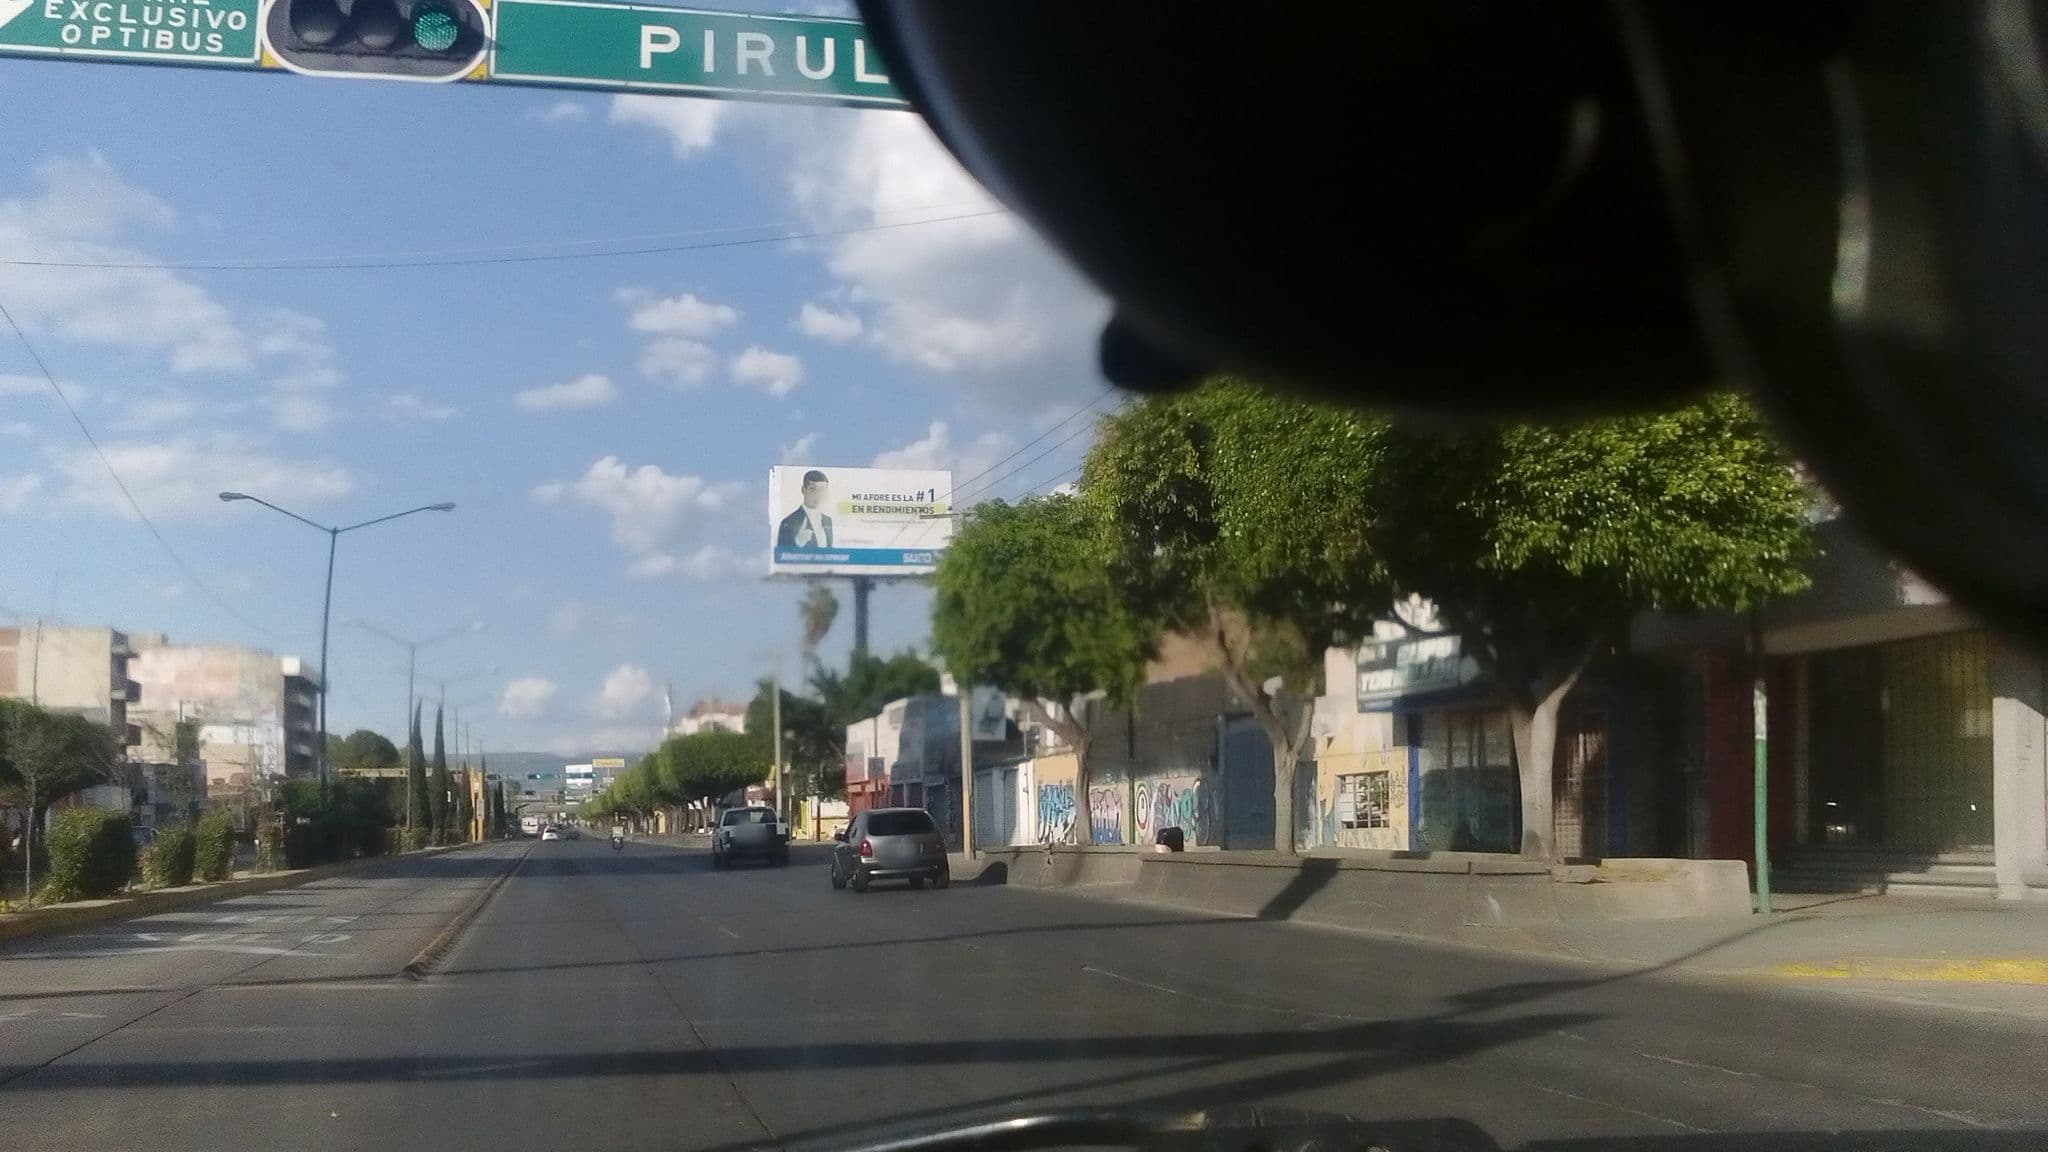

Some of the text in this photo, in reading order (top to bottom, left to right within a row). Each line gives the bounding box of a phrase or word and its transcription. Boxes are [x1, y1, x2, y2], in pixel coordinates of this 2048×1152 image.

[44, 0, 248, 30] EXCLUSIVO
[60, 23, 225, 52] OPTIBUS
[851, 493, 861, 501] MI
[863, 493, 889, 501] AFORE
[891, 493, 901, 501] ES
[903, 494, 914, 502] LA
[851, 505, 935, 515] EN RENDIMIENTOS
